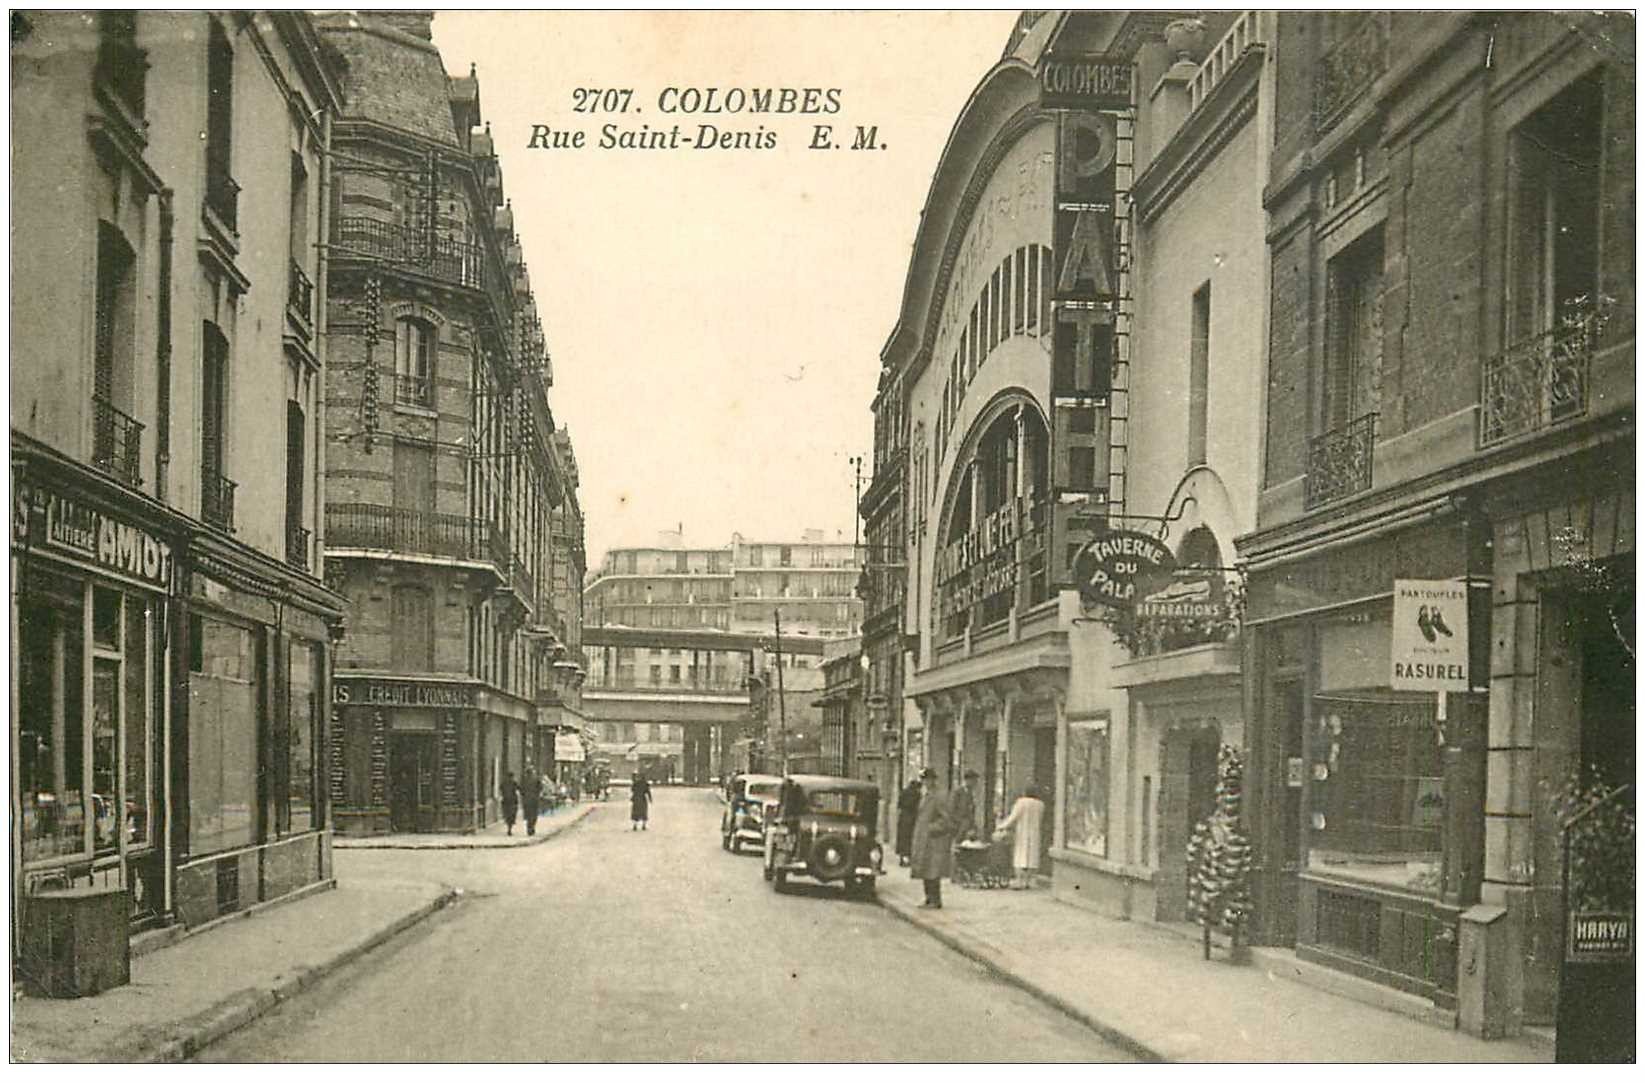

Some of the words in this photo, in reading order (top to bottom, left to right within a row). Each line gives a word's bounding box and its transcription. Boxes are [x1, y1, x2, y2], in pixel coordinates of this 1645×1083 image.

[1043, 63, 1130, 94] COLOMBES
[99, 515, 171, 583] AMIOT
[1088, 538, 1164, 565] TAVERNE
[1115, 562, 1138, 574] DU
[1395, 663, 1466, 680] RASUREL
